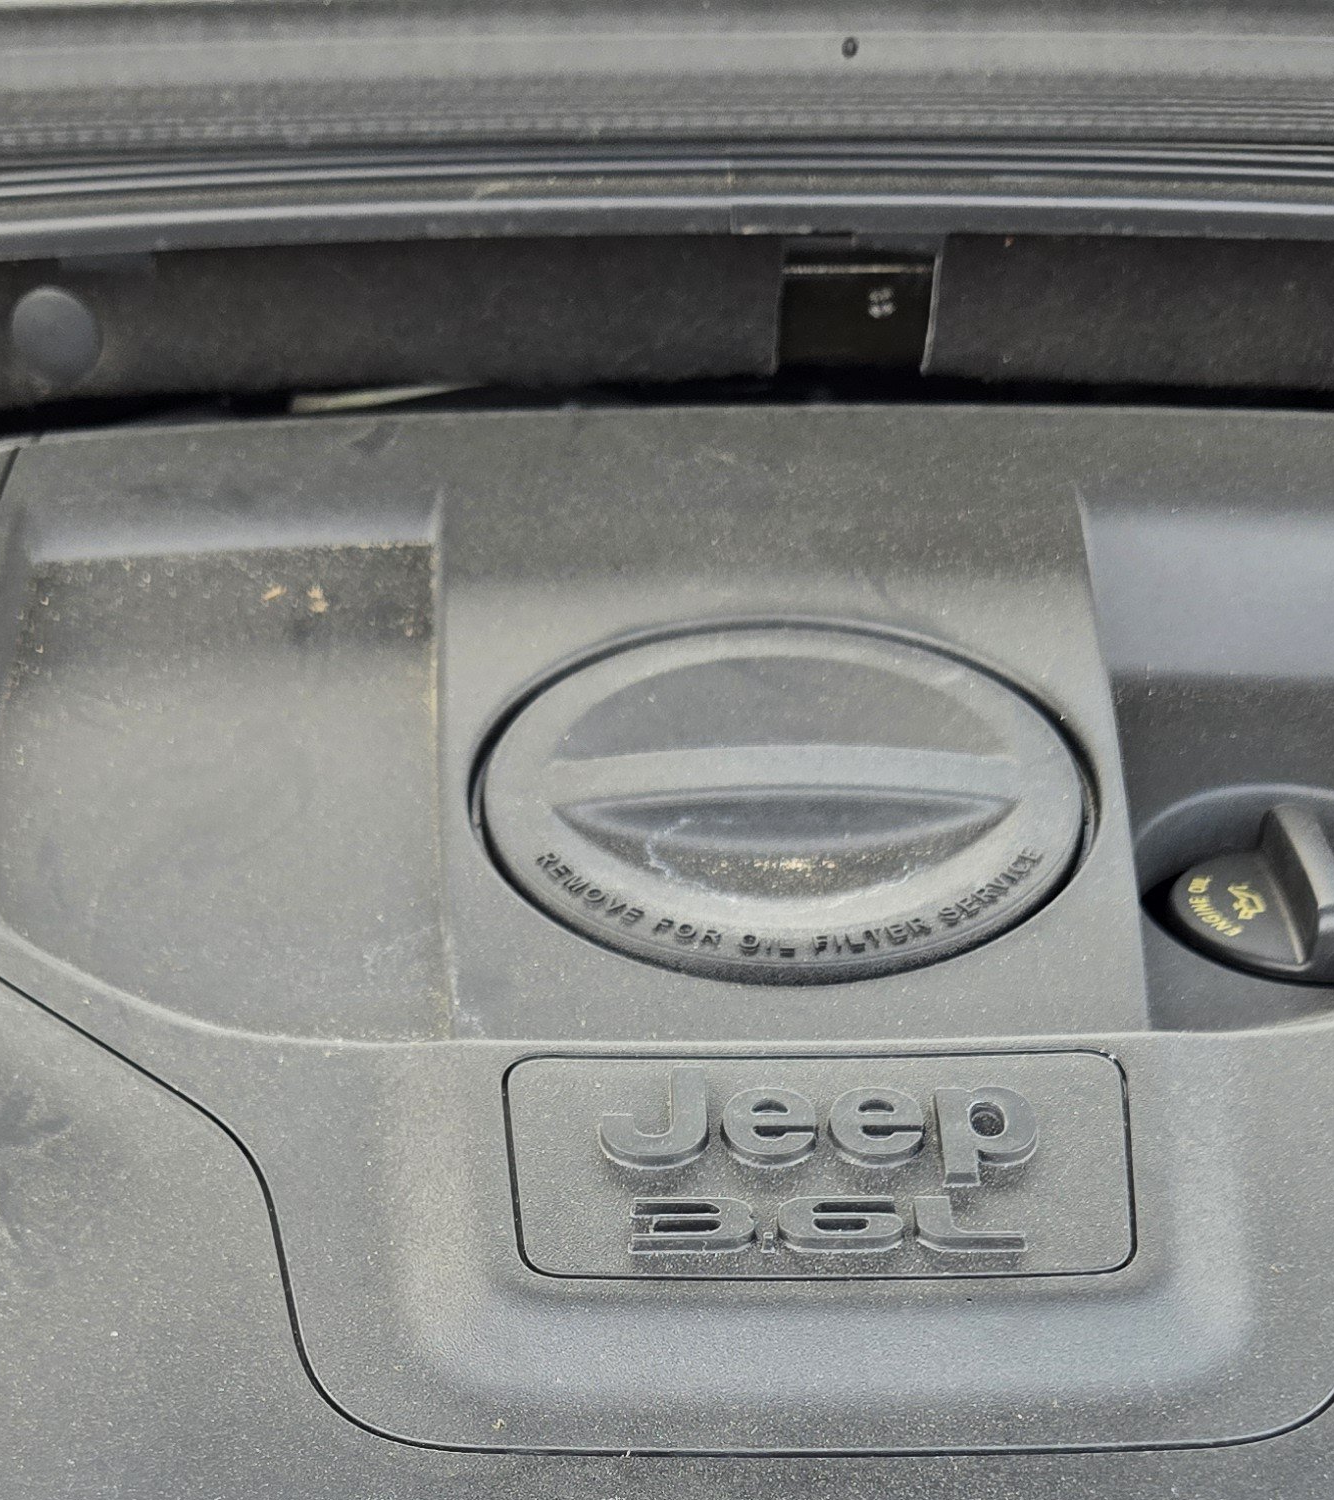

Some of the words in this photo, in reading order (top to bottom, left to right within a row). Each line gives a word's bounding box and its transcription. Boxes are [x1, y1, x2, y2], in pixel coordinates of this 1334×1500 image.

[535, 851, 645, 926] REMOVE
[652, 917, 723, 949] FOR
[738, 933, 797, 960] OIL
[810, 917, 933, 957] FILTER
[938, 847, 1045, 928] SERVICE
[1188, 895, 1244, 937] ENGINE
[598, 1066, 1038, 1188] Jeep
[627, 1195, 1029, 1255] 3.6L
